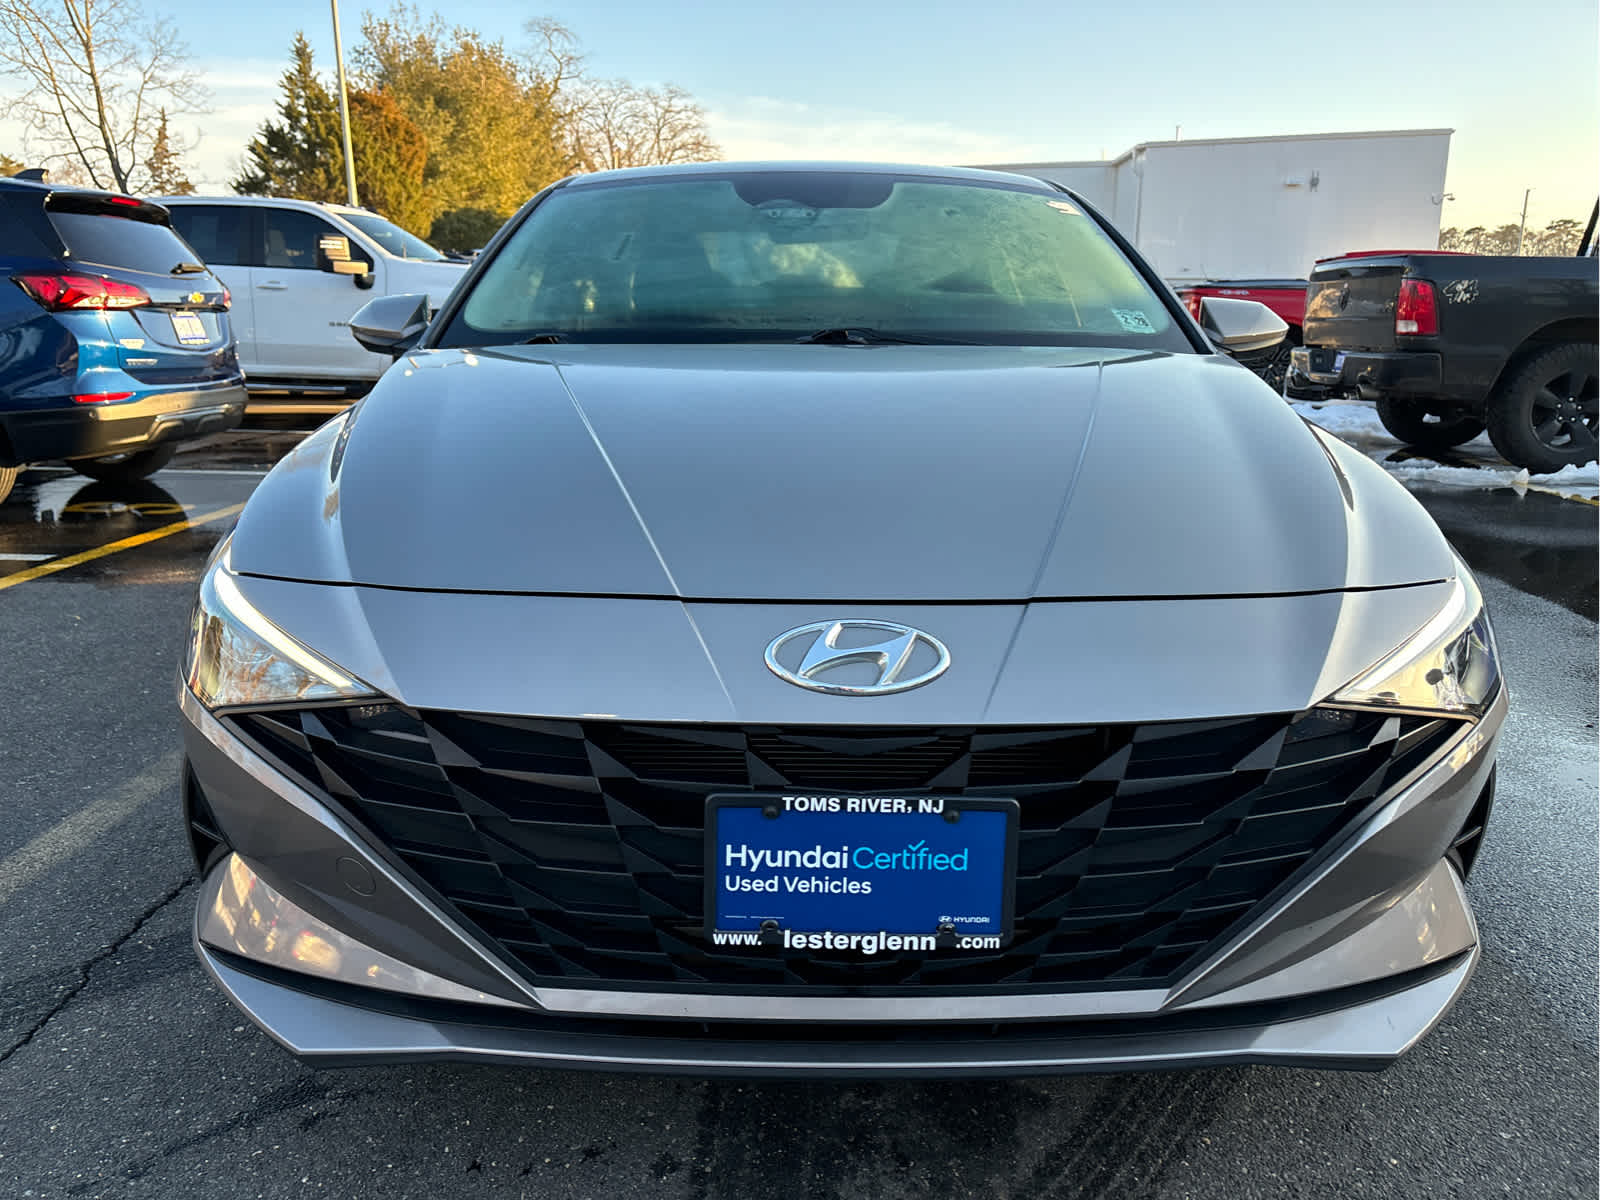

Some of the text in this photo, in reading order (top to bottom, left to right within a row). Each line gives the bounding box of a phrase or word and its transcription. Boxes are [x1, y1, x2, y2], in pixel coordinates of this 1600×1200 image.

[782, 796, 944, 814] TOMS RIVER, NJ
[725, 840, 969, 872] Hyundai Certified
[725, 875, 872, 894] Used Vehicles
[953, 916, 990, 924] HYUNDAI
[712, 930, 1000, 955] www. lesterglenn .com
